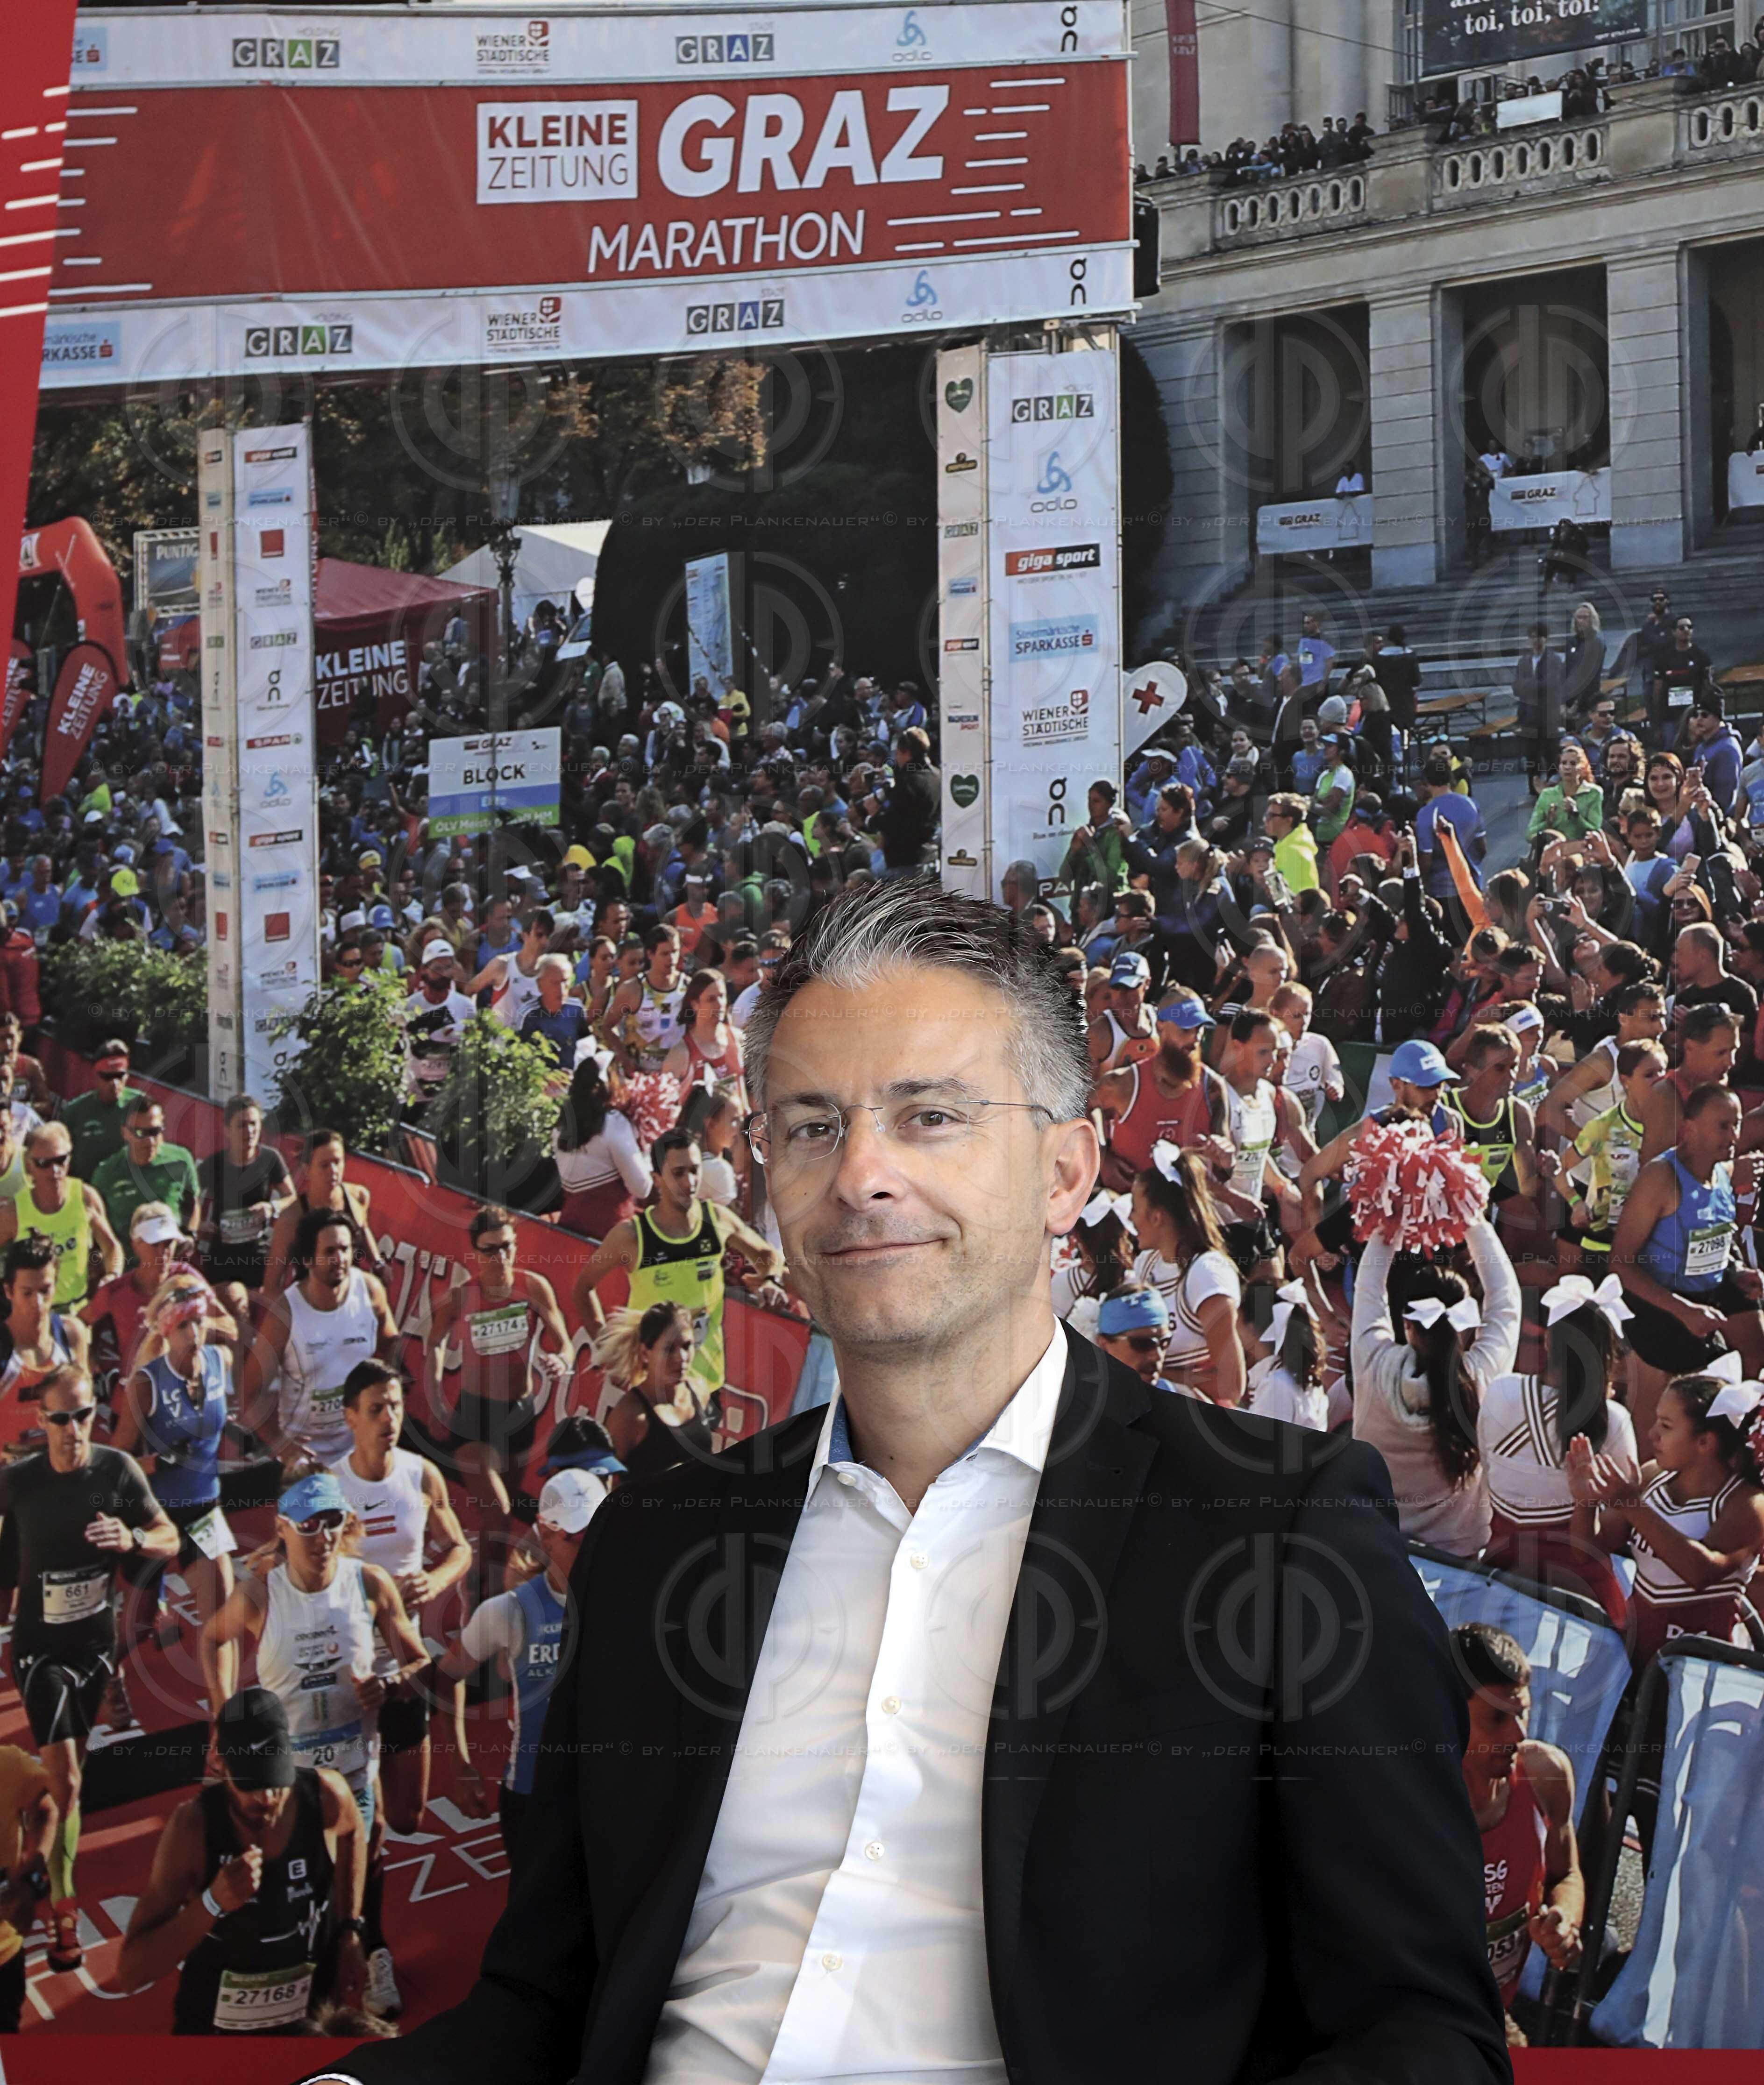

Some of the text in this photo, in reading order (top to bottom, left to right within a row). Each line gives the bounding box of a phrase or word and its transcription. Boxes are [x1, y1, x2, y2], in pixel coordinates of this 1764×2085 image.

[233, 38, 340, 68] GRAZ
[477, 35, 526, 47] WIENER
[676, 34, 774, 64] GRAZ
[488, 113, 627, 149] KLEINE
[658, 85, 949, 198] GRAZ
[488, 153, 628, 189] ZEITUNG
[588, 209, 865, 273] MARATHON
[487, 312, 537, 326] WIENER
[687, 299, 784, 335] GRAZ
[245, 324, 353, 357] GRAZ
[1012, 394, 1094, 423] GRAZ
[1031, 497, 1077, 513] odlo
[1528, 487, 1556, 499] GRAZ
[1017, 548, 1095, 572] giga sport
[1016, 635, 1080, 654] SPARKASSE
[316, 640, 405, 680] KLEINE
[57, 663, 96, 734] KLEINE
[1022, 706, 1069, 722] WIENER
[481, 738, 512, 749] GAZ
[463, 763, 525, 785] BLOCK
[481, 1319, 517, 1336] 27174
[66, 1584, 88, 1598] 661
[236, 1983, 296, 2005] 27168
